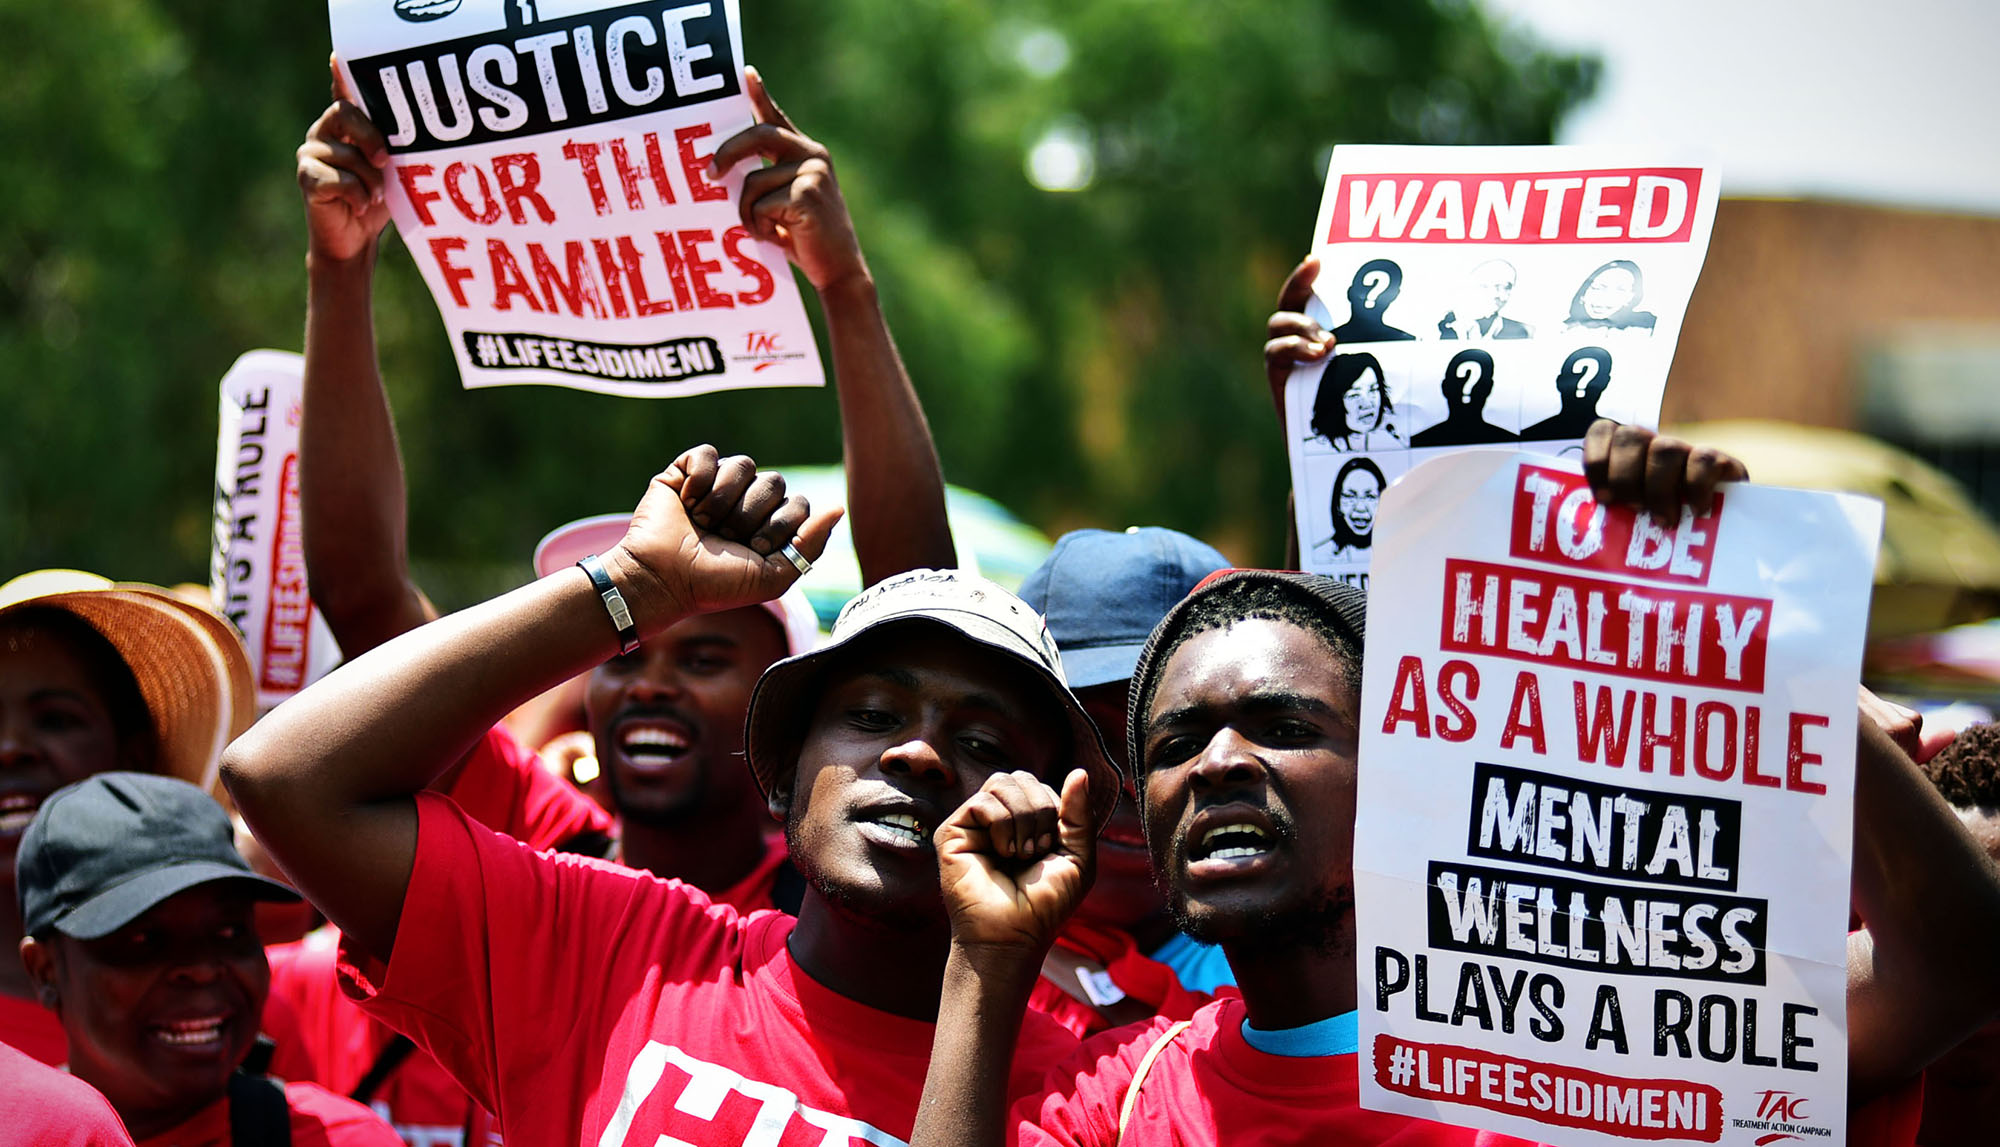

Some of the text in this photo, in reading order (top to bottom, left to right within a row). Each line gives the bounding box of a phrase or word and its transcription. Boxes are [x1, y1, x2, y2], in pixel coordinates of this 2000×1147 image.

[378, 5, 726, 148] JUSTICE
[395, 122, 729, 227] FOR THE
[1347, 175, 1689, 240] WANTED
[429, 225, 775, 320] FAMILIES
[476, 335, 717, 379] #LIFEESIDIMENI
[741, 331, 784, 353] TAC
[1524, 473, 1713, 579] TO BE
[1452, 571, 1763, 682] HEALTHY
[1381, 655, 1829, 795] AS A WHOLE
[1478, 777, 1730, 883] MENTAL
[1437, 872, 1758, 974] WELLNESS
[1375, 946, 1819, 1073] PLAYS A ROLE
[1389, 1045, 1707, 1131] #LIFEESIDIMENI
[1732, 1118, 1832, 1137] TREATMENT ACTION CAMPAIGN
[1754, 1089, 1810, 1123] TAC
